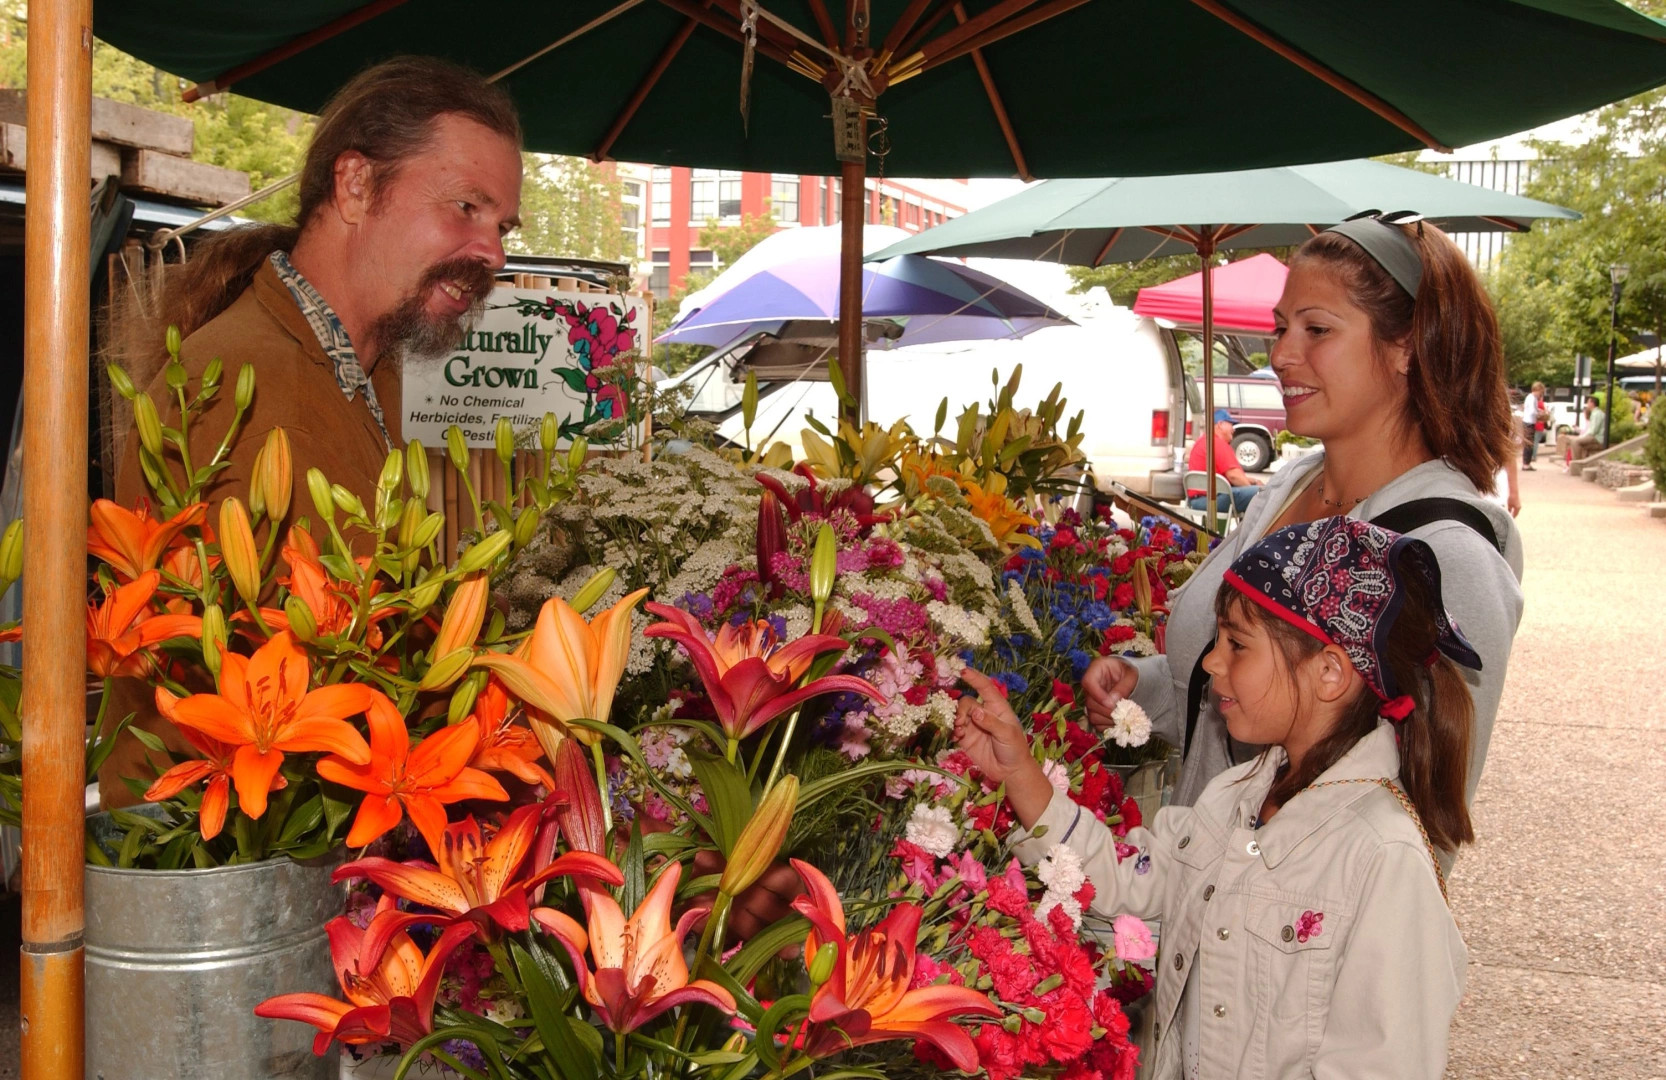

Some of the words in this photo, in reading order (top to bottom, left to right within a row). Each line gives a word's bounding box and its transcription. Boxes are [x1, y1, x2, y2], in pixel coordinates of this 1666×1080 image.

[456, 322, 554, 365] turally
[444, 356, 539, 389] Grown
[440, 395, 459, 407] No
[463, 395, 525, 408] Chemical
[409, 411, 486, 425] Herbicides,
